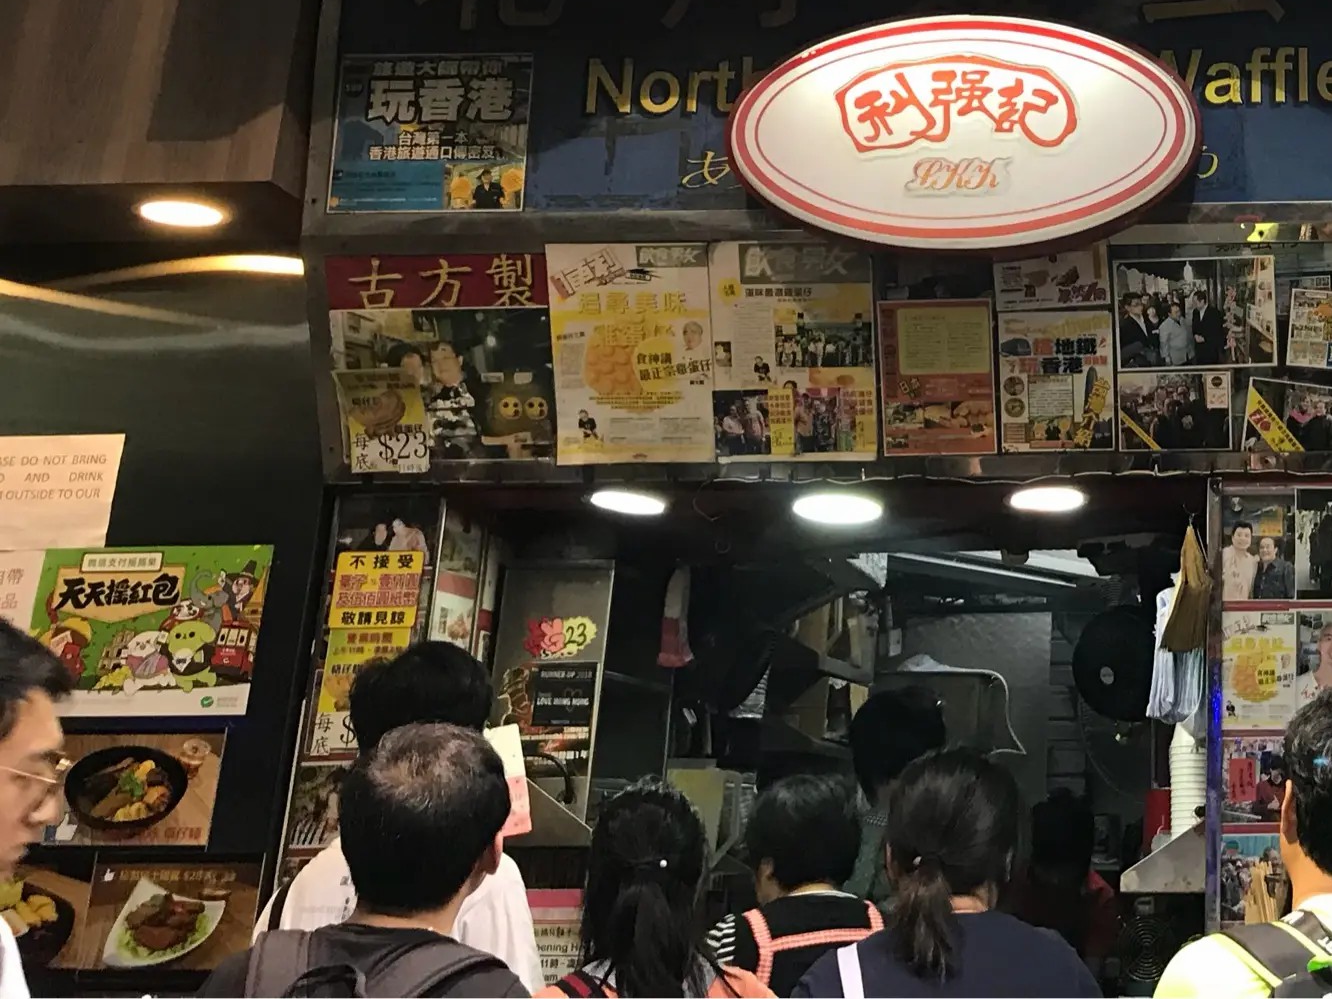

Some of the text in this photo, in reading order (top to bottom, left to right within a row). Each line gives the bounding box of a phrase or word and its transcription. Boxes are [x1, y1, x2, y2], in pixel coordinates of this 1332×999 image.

[367, 76, 514, 124] 玩香港
[349, 254, 536, 309] 古方製
[378, 431, 428, 463] $23
[20, 455, 39, 466] DO
[43, 455, 68, 465] NOT
[72, 454, 107, 465] BRING
[24, 471, 104, 482] AND DRINK
[5, 488, 101, 500] OUTSIDE TO OUR
[349, 554, 414, 569] 不接受
[341, 611, 405, 625] 敬請見諒
